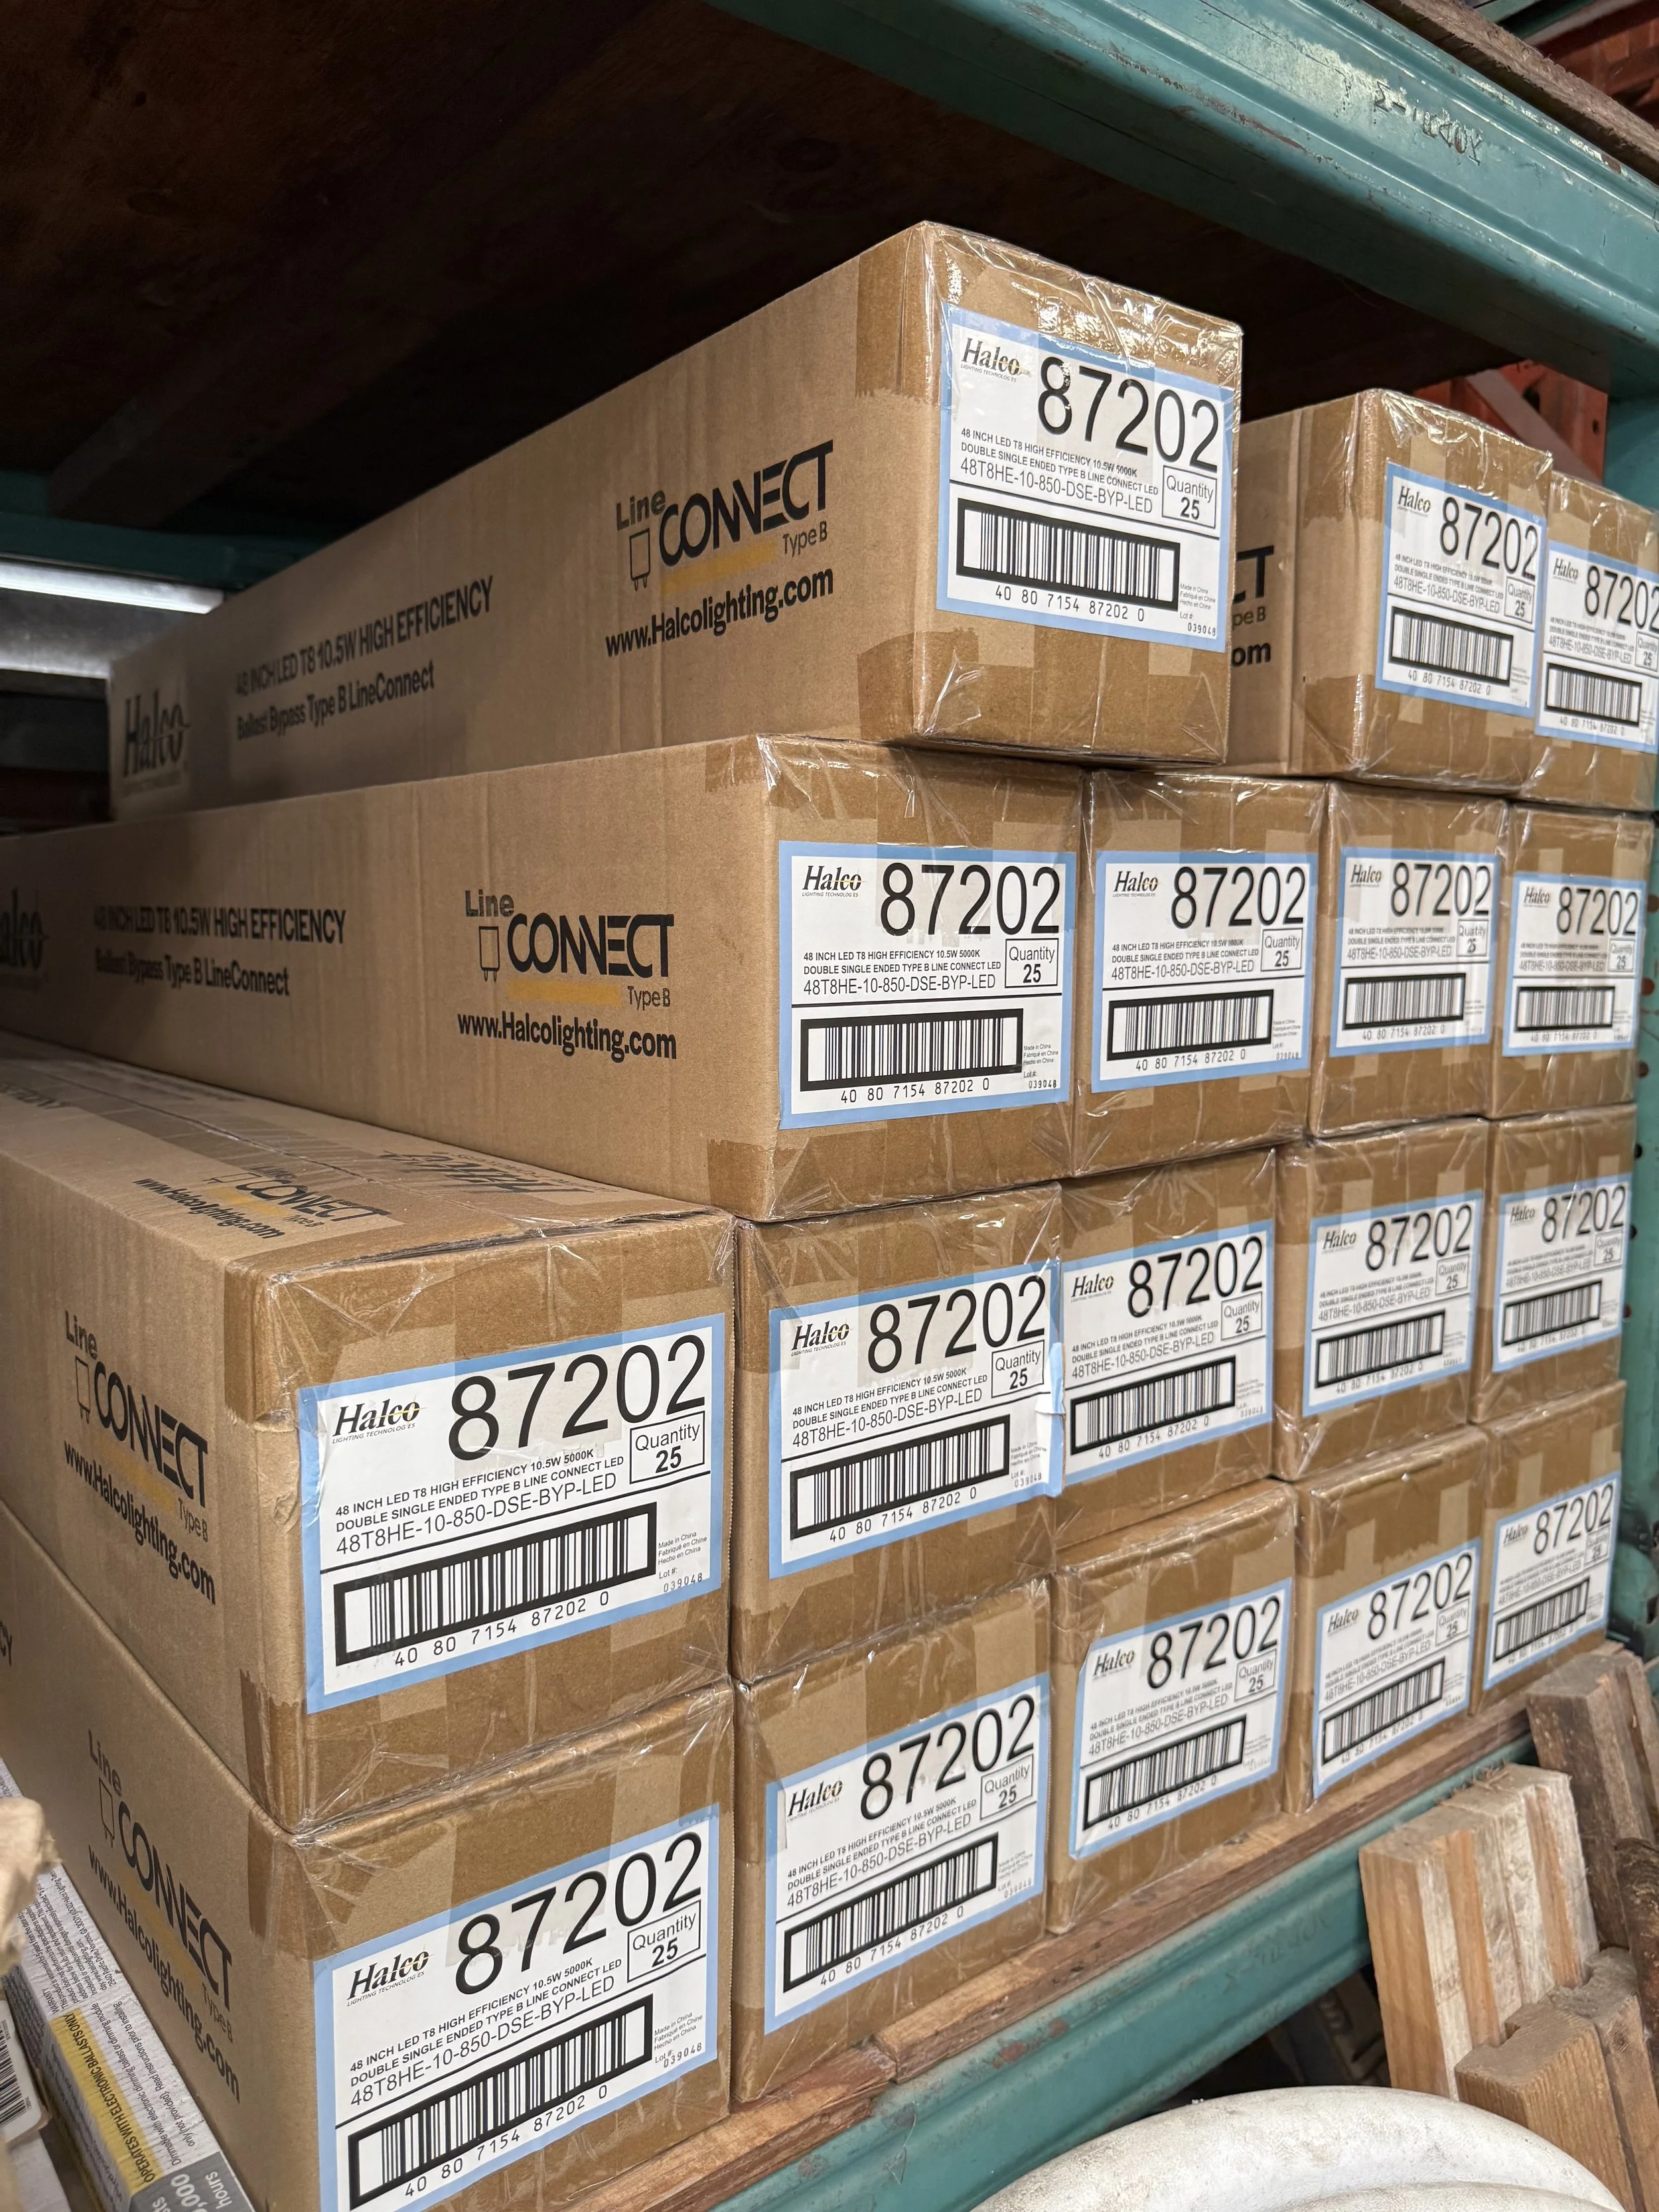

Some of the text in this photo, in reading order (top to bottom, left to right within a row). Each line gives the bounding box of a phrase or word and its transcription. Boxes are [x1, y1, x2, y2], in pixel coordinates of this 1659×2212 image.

[961, 336, 1020, 376] Halco
[1037, 356, 1219, 472] 87202
[659, 439, 833, 567] CONNECT
[960, 457, 1152, 513] 48T8HE-10-850-DSE-BYP-LED
[1398, 485, 1431, 514] Halco
[616, 490, 666, 532] Line
[1179, 497, 1200, 521] 25
[782, 520, 828, 557] Type B
[1439, 496, 1540, 581] 87202
[605, 567, 833, 658] www.Halcolighting.com
[1514, 600, 1526, 618] 25
[277, 652, 298, 684] LED
[300, 645, 316, 676] T8
[317, 628, 357, 670] 10.5W
[359, 614, 394, 657] HIGH
[397, 575, 493, 643] EFFICIENCY
[307, 693, 335, 728] Type
[338, 684, 346, 715] B
[349, 658, 435, 711] LineConnect
[802, 864, 862, 891] Halco
[1114, 869, 1159, 891] Halco
[1349, 863, 1382, 883] Halco
[1390, 861, 1491, 917] 87202
[465, 889, 514, 917] Line
[880, 861, 1060, 935] 87202
[1170, 865, 1307, 928] 87202
[1555, 885, 1638, 936] 87202
[214, 907, 248, 939] HIGH
[250, 907, 346, 944] EFFICIENCY
[507, 913, 675, 978] CONNECT
[1273, 950, 1289, 968] 25
[1466, 938, 1478, 954] 25
[165, 954, 192, 990] Type
[193, 956, 202, 986] B
[204, 957, 290, 997] LineConnect
[803, 973, 995, 995] 48T8HE-10-850-DSE-BYP-LED
[1022, 963, 1042, 984] 25
[627, 986, 671, 1011] Type B
[457, 1011, 677, 1063] www.Halcolighting.com
[133, 1177, 285, 1239] www.Halcolighting.com
[235, 1179, 391, 1222] CONNECT
[1541, 1184, 1625, 1243] 87202
[1322, 1228, 1356, 1250] Halco
[1365, 1204, 1473, 1271] 87202
[1070, 1272, 1114, 1298] Halco
[1127, 1235, 1263, 1318] 87202
[1445, 1274, 1459, 1291] 25
[64, 1309, 98, 1361] Line
[791, 1319, 849, 1351] Halco
[867, 1275, 1046, 1373] 87202
[1234, 1314, 1250, 1335] 25
[448, 1335, 706, 1460] 87202
[1009, 1367, 1029, 1390] 25
[94, 1361, 208, 1509] CONNECT
[332, 1398, 420, 1436] Halco
[792, 1387, 981, 1447] 48T8HE-10-850-DSE-BYP-LED
[332, 1433, 364, 1443] LIGHTING
[634, 1423, 701, 1451] Quantity
[654, 1445, 682, 1473] 25
[336, 1447, 593, 1516] 48 INCH LED T8 HIGH EFFICIENCY 10.5W 5000K
[336, 1455, 623, 1533] DOUBLE SINGLE ENDED TYPE B LINE CONNECT LED
[64, 1440, 216, 1605] www.Halcolighting.com
[178, 1497, 208, 1544] Type B
[336, 1471, 616, 1555] 48T8HE-10-850-DSE-BYP-LED
[1533, 1483, 1614, 1555] 87202
[682, 1532, 697, 1540] China
[658, 1569, 670, 1579] Lot
[664, 1573, 703, 1593] 039048
[1367, 1551, 1472, 1641] 87202
[394, 1590, 609, 1668] 40 80 7154 87202 0
[1146, 1595, 1282, 1689] 87202
[1092, 1649, 1135, 1677] Halco
[1247, 1673, 1263, 1694] 25
[88, 1729, 122, 1797] Line
[859, 1694, 1035, 1820] 87202
[786, 1781, 843, 1817] Halco
[997, 1783, 1017, 1808] 25
[118, 1800, 232, 2011] CONNECT
[455, 1832, 701, 1995] 87202
[651, 1936, 678, 1968] 25
[88, 1844, 241, 2104] www.Halcolighting.com
[346, 1951, 429, 2000] Halco
[64, 2013, 80, 2032] ONLY
[92, 2002, 106, 2023] module
[202, 1981, 227, 2033] Type
[102, 2020, 118, 2044] dimming
[125, 2023, 133, 2031] to
[127, 2029, 141, 2043] prior
[350, 1975, 614, 2105] 48T8HE-10-850-DSE-BYP-LED
[73, 2029, 99, 2069] BALLASTS
[115, 2048, 131, 2070] ballast
[135, 2041, 157, 2079] instructions
[90, 2066, 123, 2117] ELECTRONIC
[125, 2066, 143, 2092] dimming
[150, 2073, 165, 2091] Read
[138, 2091, 158, 2121] electronic
[113, 2113, 133, 2140] WITH
[151, 2120, 165, 2136] with
[175, 2120, 190, 2134] (not
[182, 2132, 195, 2147] only
[125, 2136, 156, 2183] OPERATES
[171, 2174, 208, 2212] ,000
[205, 2172, 233, 2209] hours
